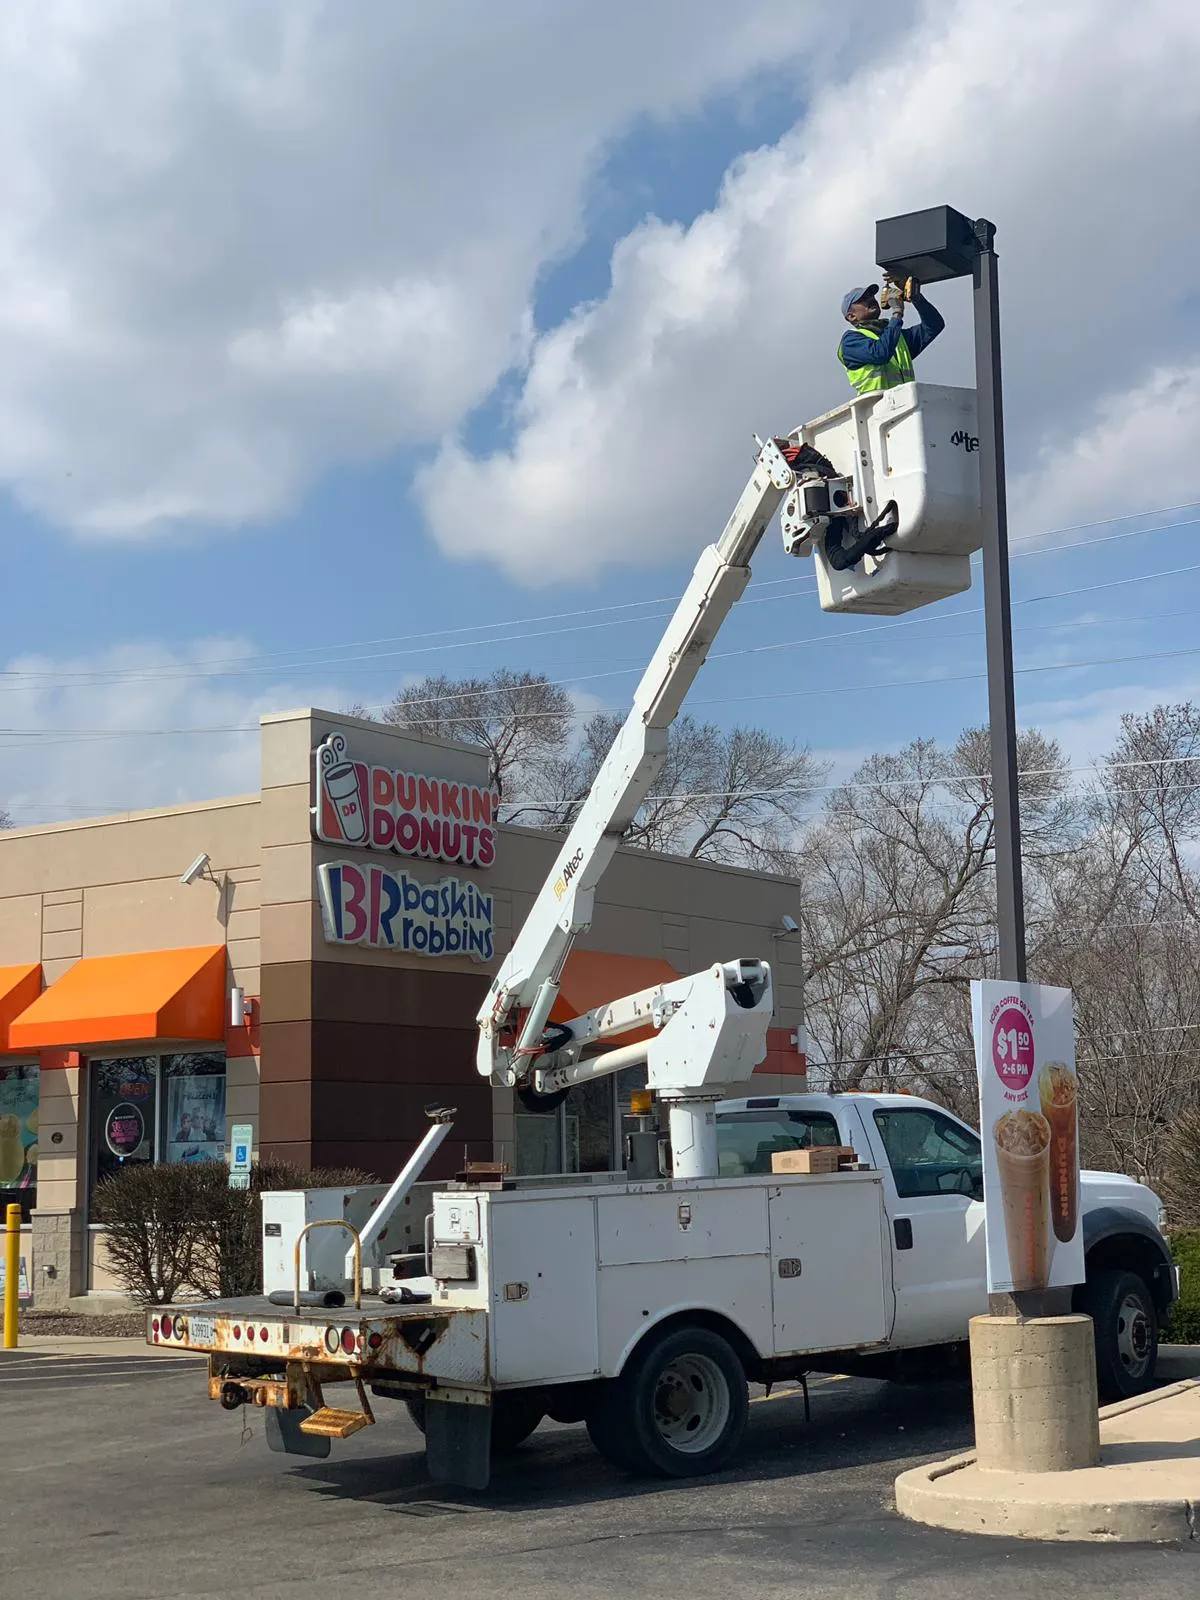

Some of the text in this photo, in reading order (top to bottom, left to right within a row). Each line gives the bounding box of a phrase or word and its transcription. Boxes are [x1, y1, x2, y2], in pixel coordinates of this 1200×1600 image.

[950, 430, 979, 452] Alte
[372, 768, 498, 825] DUNKIN'
[372, 808, 494, 864] DONUTS
[563, 847, 584, 887] Altec
[328, 865, 401, 944] BR
[990, 996, 1035, 1027] ICED COFFEE OR TEA
[1002, 1063, 1029, 1075] 2-6 PM
[1004, 1090, 1029, 1102] ANY SIZE
